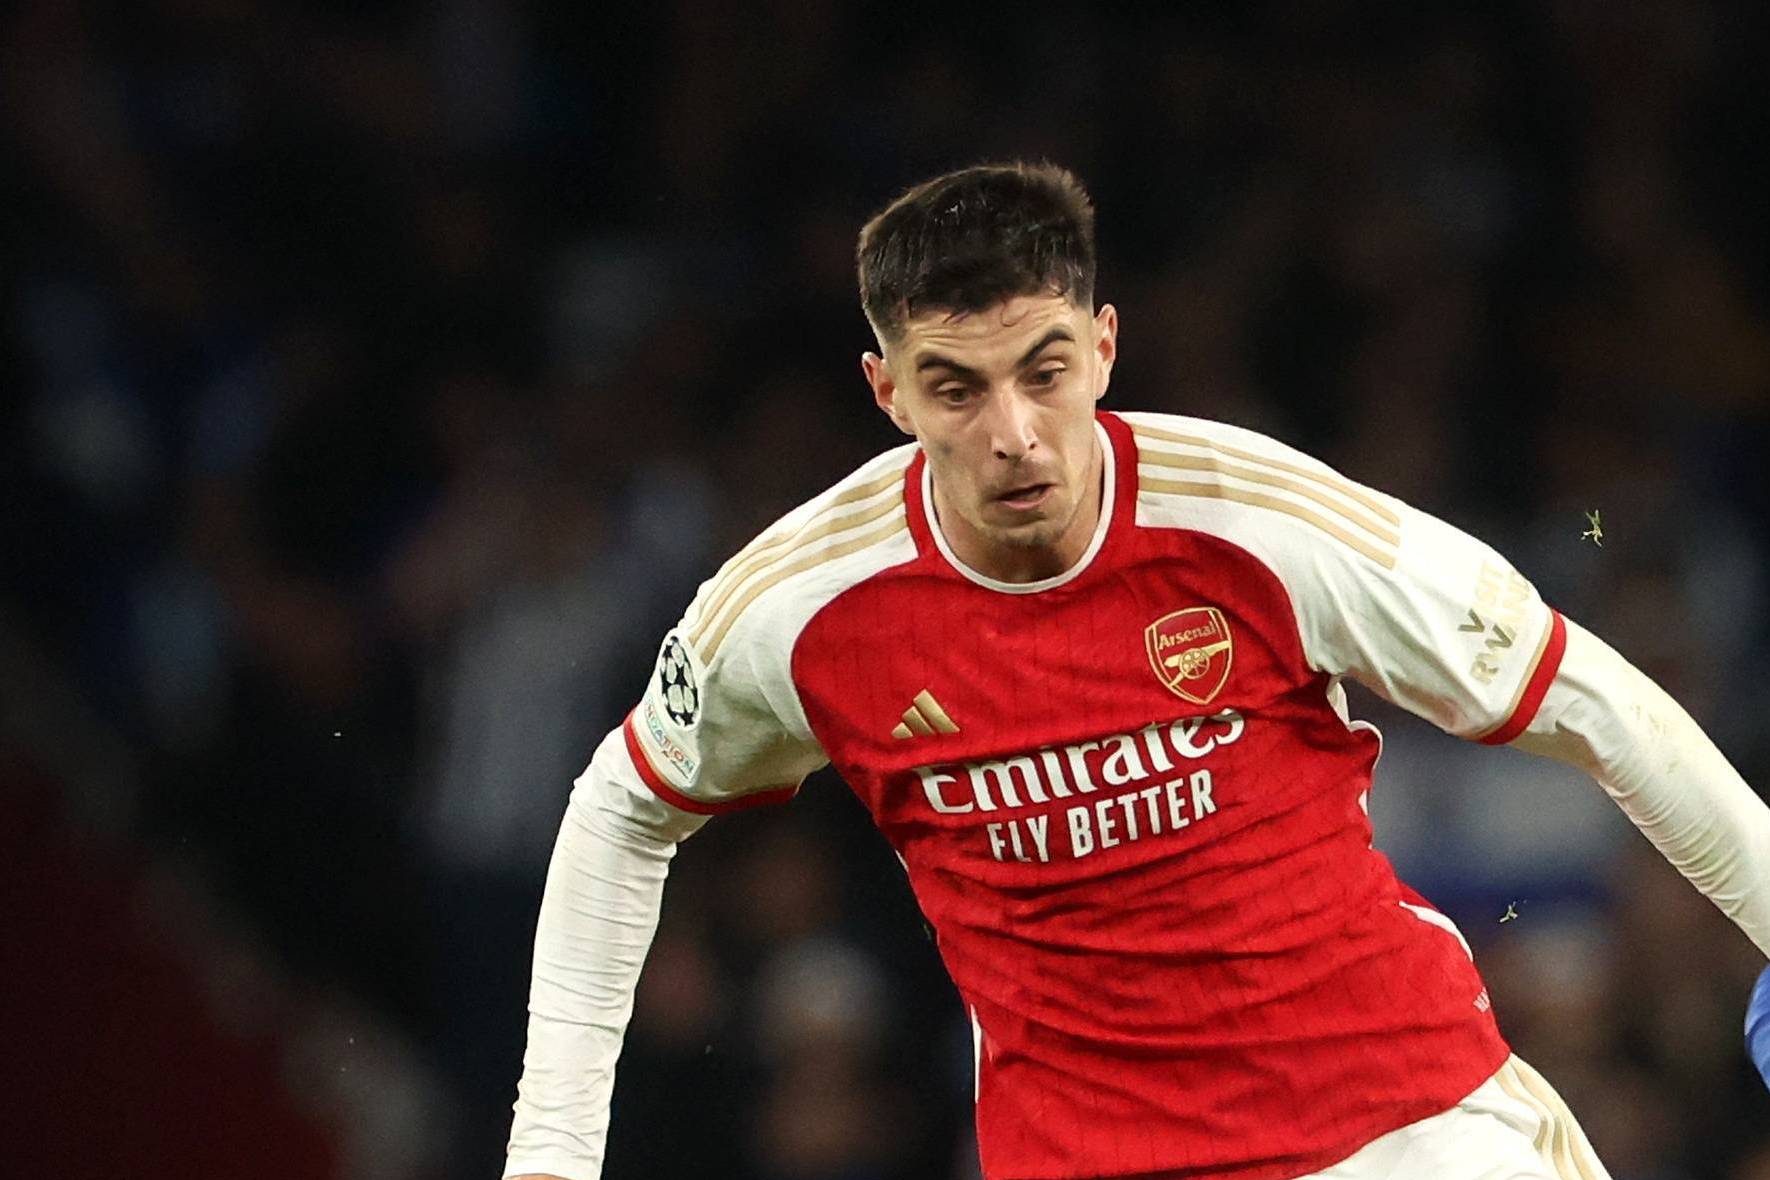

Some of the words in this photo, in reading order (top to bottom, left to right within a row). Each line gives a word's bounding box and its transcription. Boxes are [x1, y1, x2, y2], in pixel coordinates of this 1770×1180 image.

[1158, 620, 1218, 651] Arsenal
[913, 707, 1245, 814] Emirates
[987, 815, 1049, 864] FLY
[1066, 768, 1218, 859] BETTER
